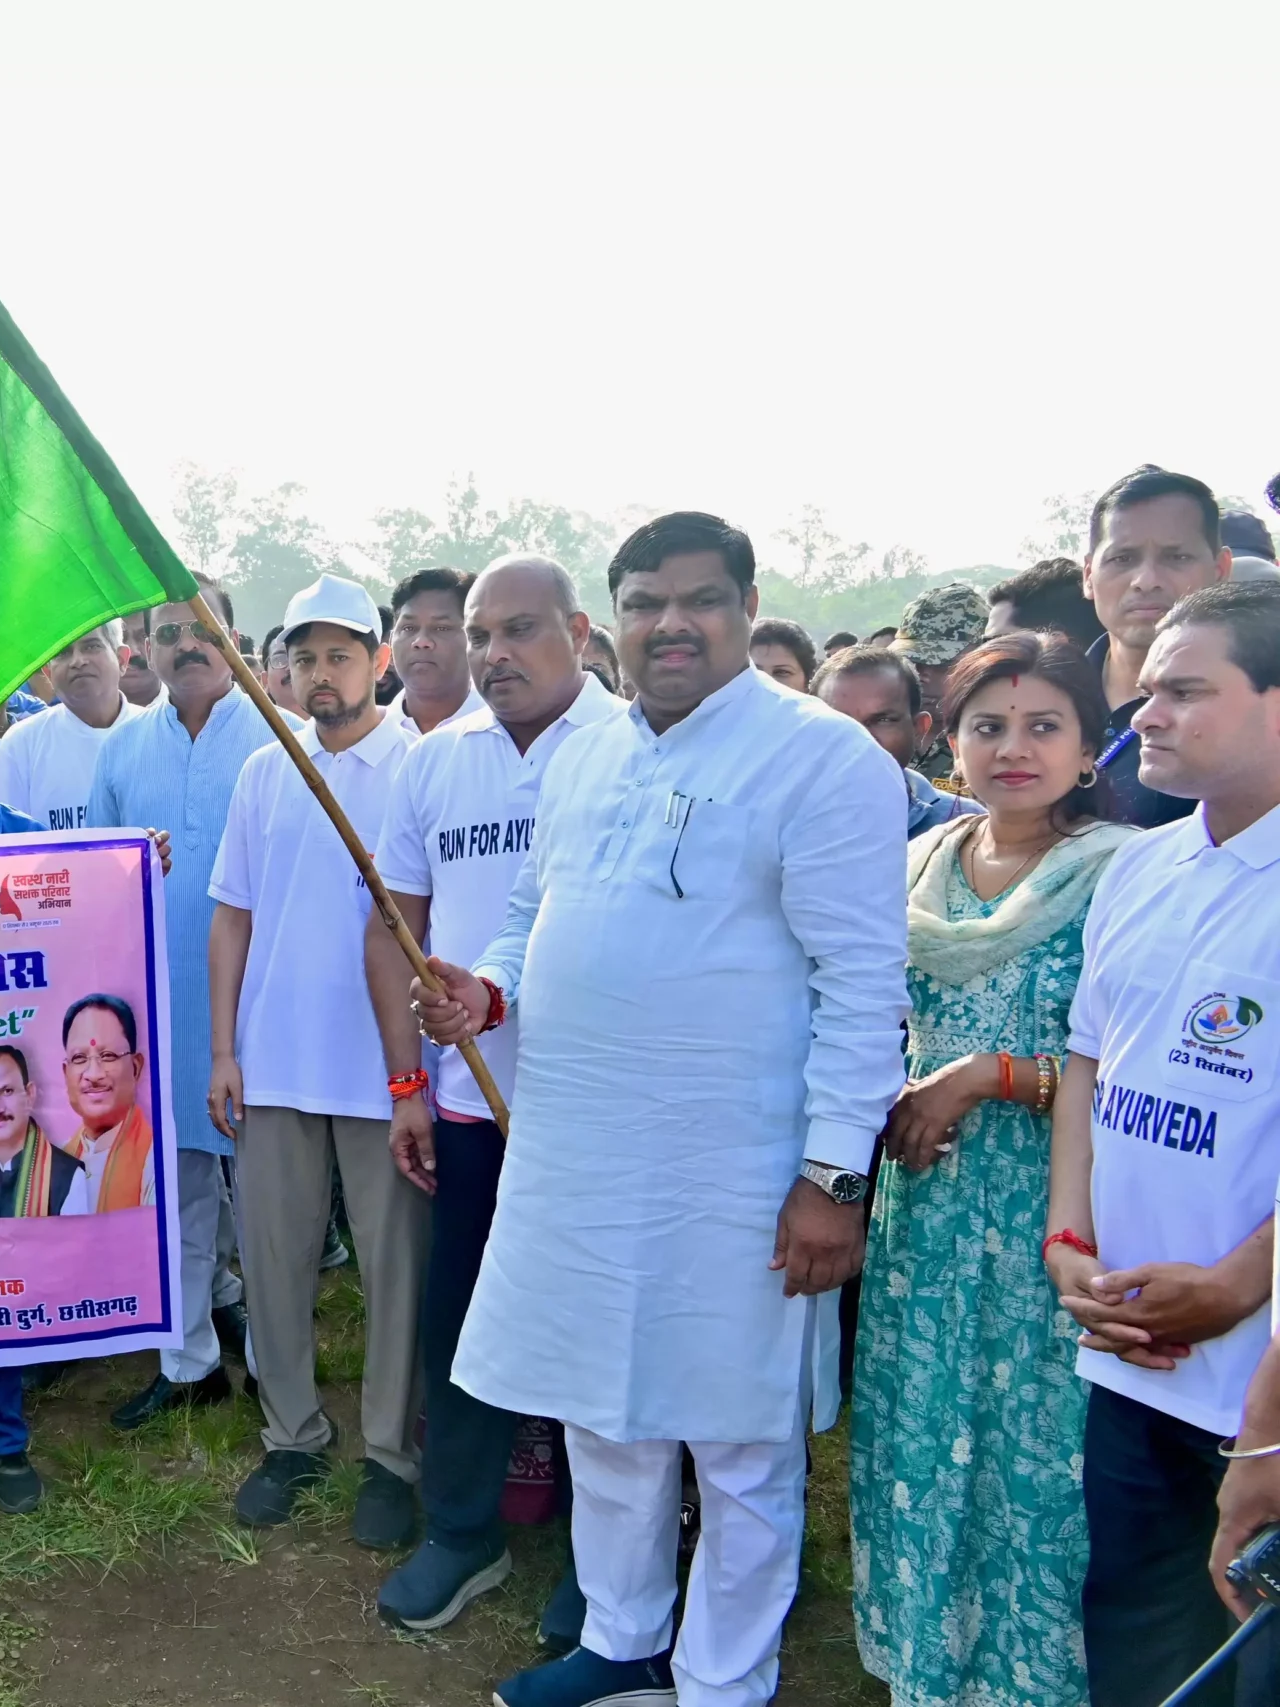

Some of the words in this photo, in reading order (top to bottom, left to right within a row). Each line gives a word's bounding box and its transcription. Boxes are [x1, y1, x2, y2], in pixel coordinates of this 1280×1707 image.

[48, 807, 74, 831] RUN
[439, 827, 466, 864] RUN
[469, 822, 501, 858] FOR
[12, 874, 43, 887] स्वस्थ
[45, 869, 70, 884] नारी
[13, 888, 39, 900] सशक्त
[41, 885, 71, 897] परिवार
[37, 898, 72, 910] अभियान
[1168, 1048, 1190, 1065] (23
[1195, 1056, 1254, 1083] सितंबर)
[1102, 1084, 1218, 1159] AYURVEDA
[16, 1303, 52, 1331] दुर्ग,
[58, 1296, 139, 1323] छत्तीसगढ़
